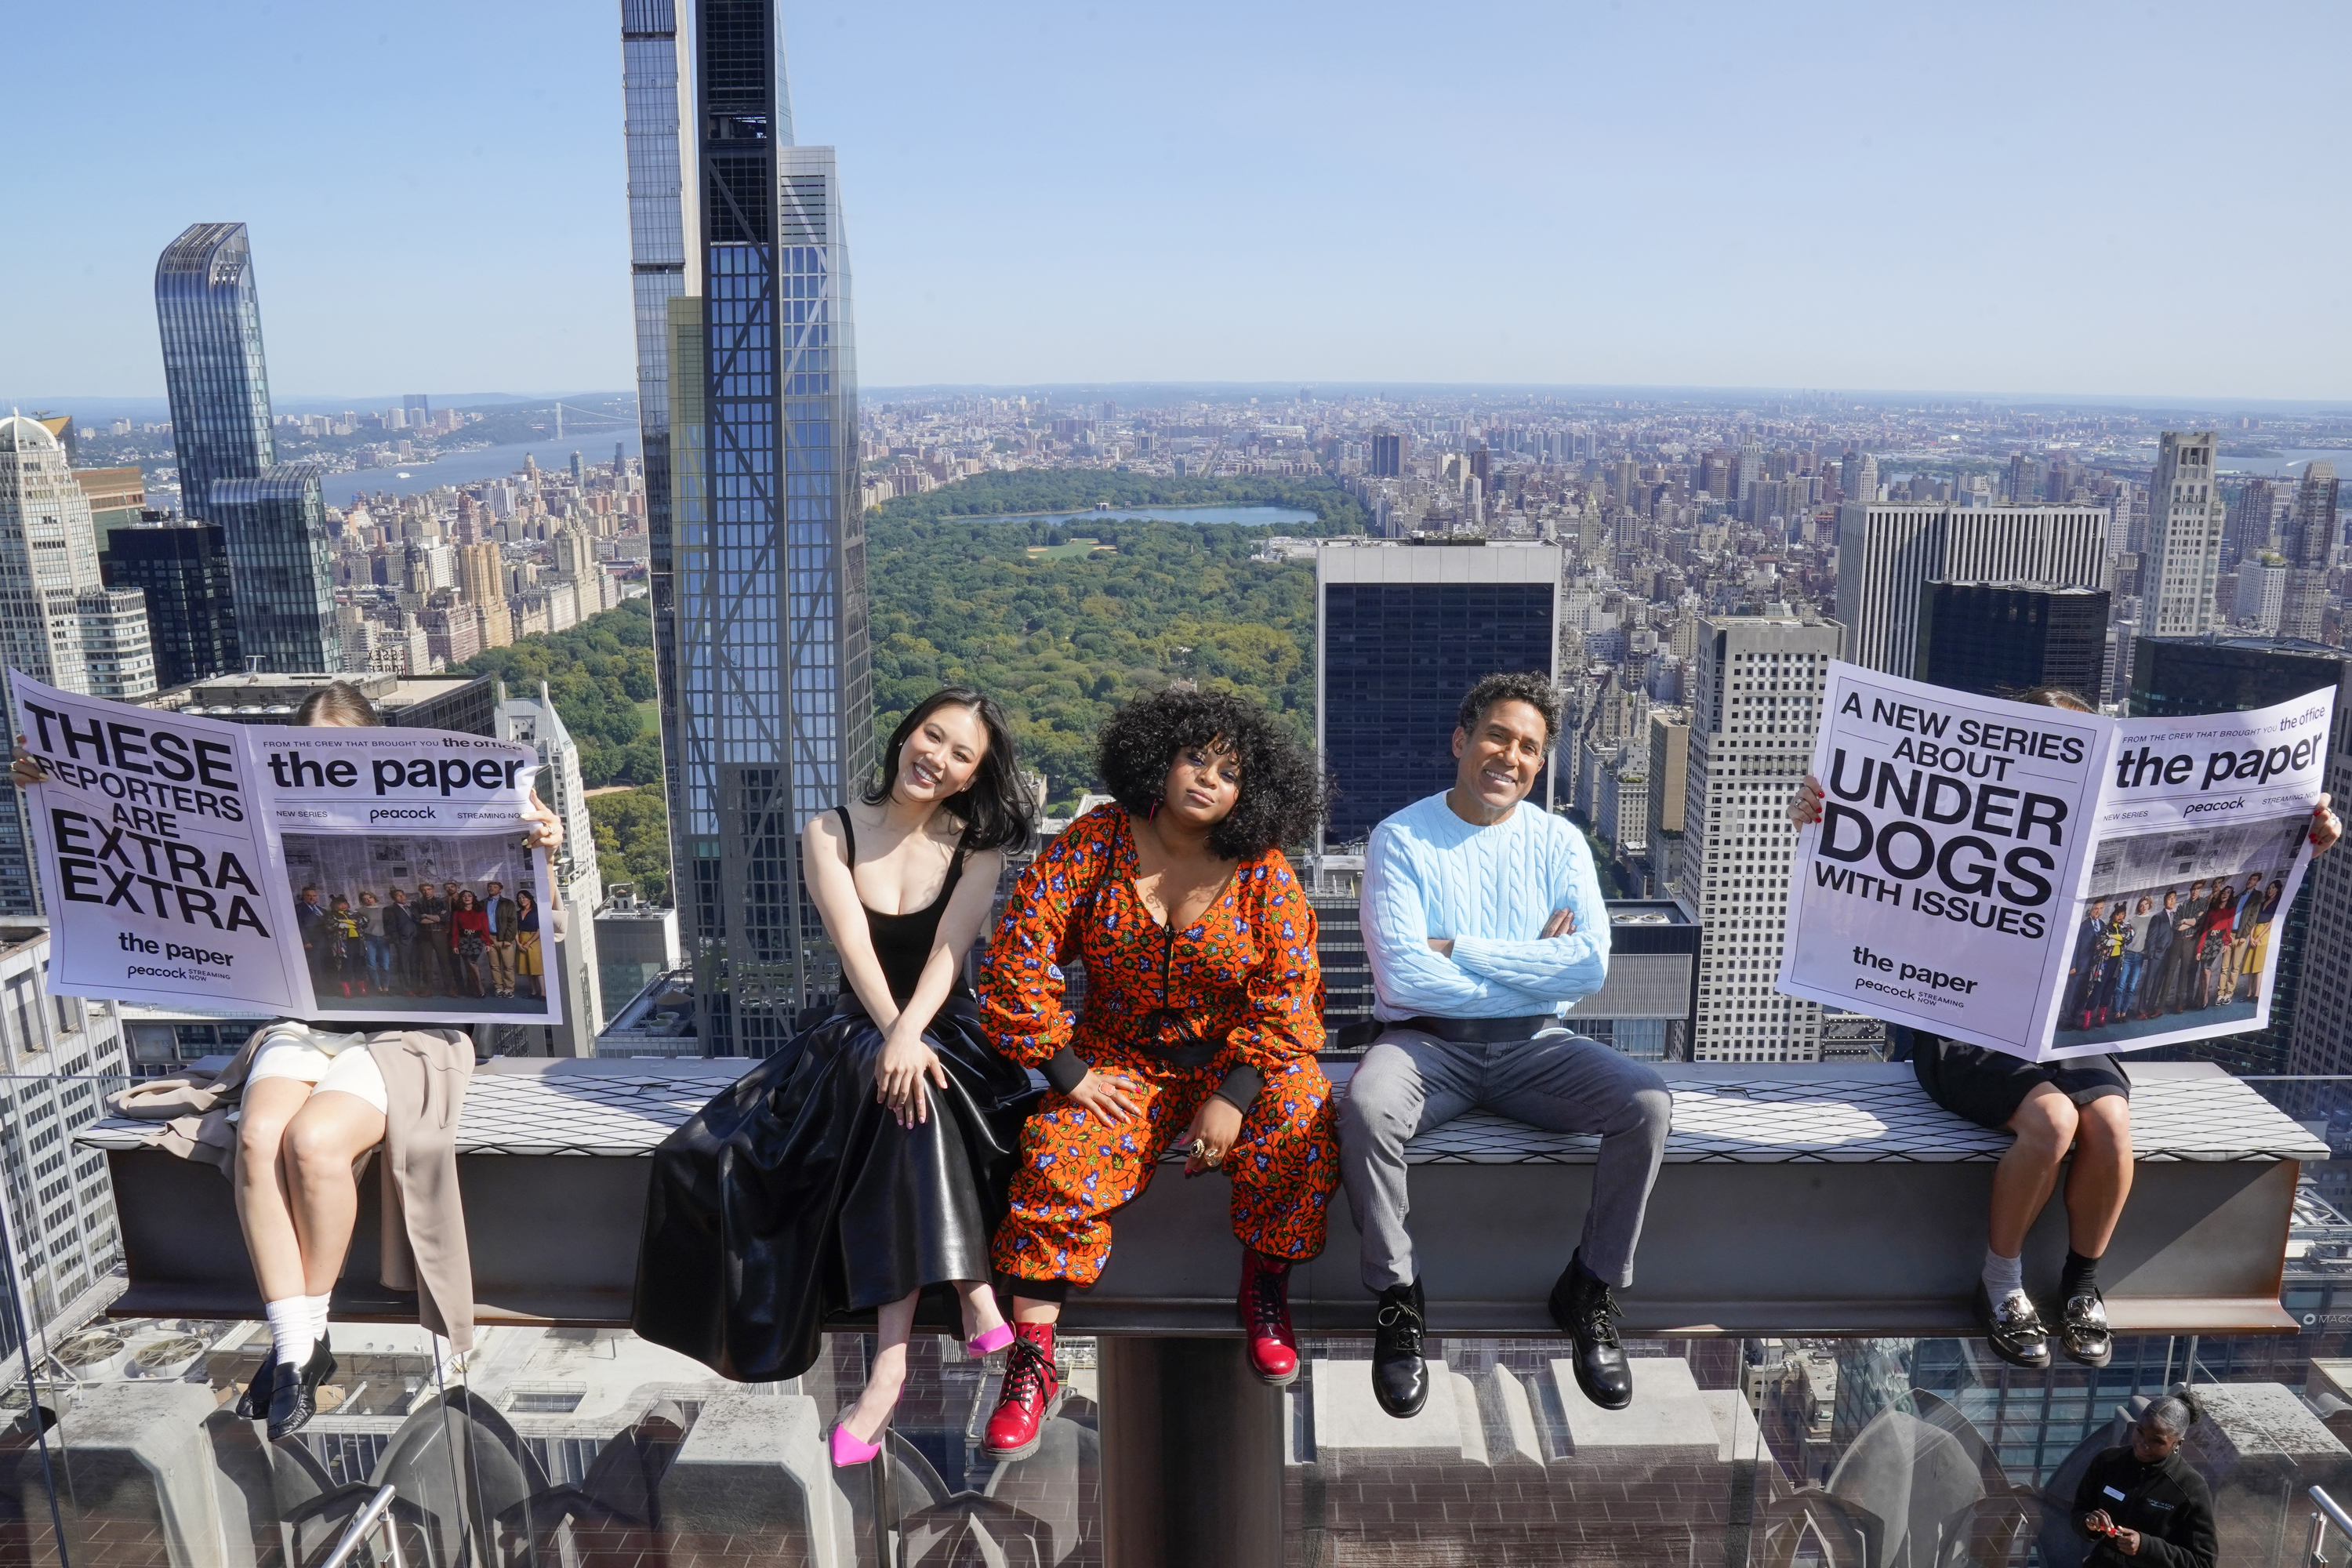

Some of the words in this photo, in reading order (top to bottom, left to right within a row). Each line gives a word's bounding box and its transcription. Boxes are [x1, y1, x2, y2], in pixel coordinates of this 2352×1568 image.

[1841, 692, 1863, 719] A
[1872, 699, 1951, 738] NEW
[1958, 720, 2084, 764] SERIES
[2150, 733, 2166, 742] THE
[2168, 731, 2194, 740] CREW
[2220, 728, 2262, 737] BROUGHT
[2280, 717, 2298, 731] the
[2299, 707, 2325, 725] office
[24, 700, 238, 792] THESE
[442, 738, 470, 748] the
[473, 739, 523, 751] office
[1893, 737, 2014, 781] ABOUT
[2116, 746, 2193, 789] the
[2200, 733, 2322, 790] paper
[33, 753, 244, 822] REPORTERS
[267, 751, 358, 787] the
[372, 759, 524, 797] paper
[370, 807, 436, 823] peacock
[1830, 748, 2068, 846] UNDER
[2122, 811, 2149, 819] SERIES
[2183, 797, 2246, 818] peacock
[2262, 794, 2303, 805] STREAMING
[2304, 789, 2318, 799] NOW
[113, 803, 180, 839] ARE
[51, 808, 260, 896] EXTRA
[1818, 801, 2055, 906] DOGS
[59, 857, 270, 938] EXTRA
[1815, 861, 1901, 906] WITH
[1913, 889, 2045, 939] ISSUES
[118, 932, 159, 954] the
[165, 942, 234, 966] paper
[128, 965, 187, 978] peacock
[188, 968, 231, 979] STREAMING
[1853, 946, 1893, 971] the
[1900, 963, 1978, 994] paper
[1855, 978, 1915, 1001] peacock
[1918, 991, 1964, 1007] STREAMING
[1918, 997, 1936, 1006] NOW
